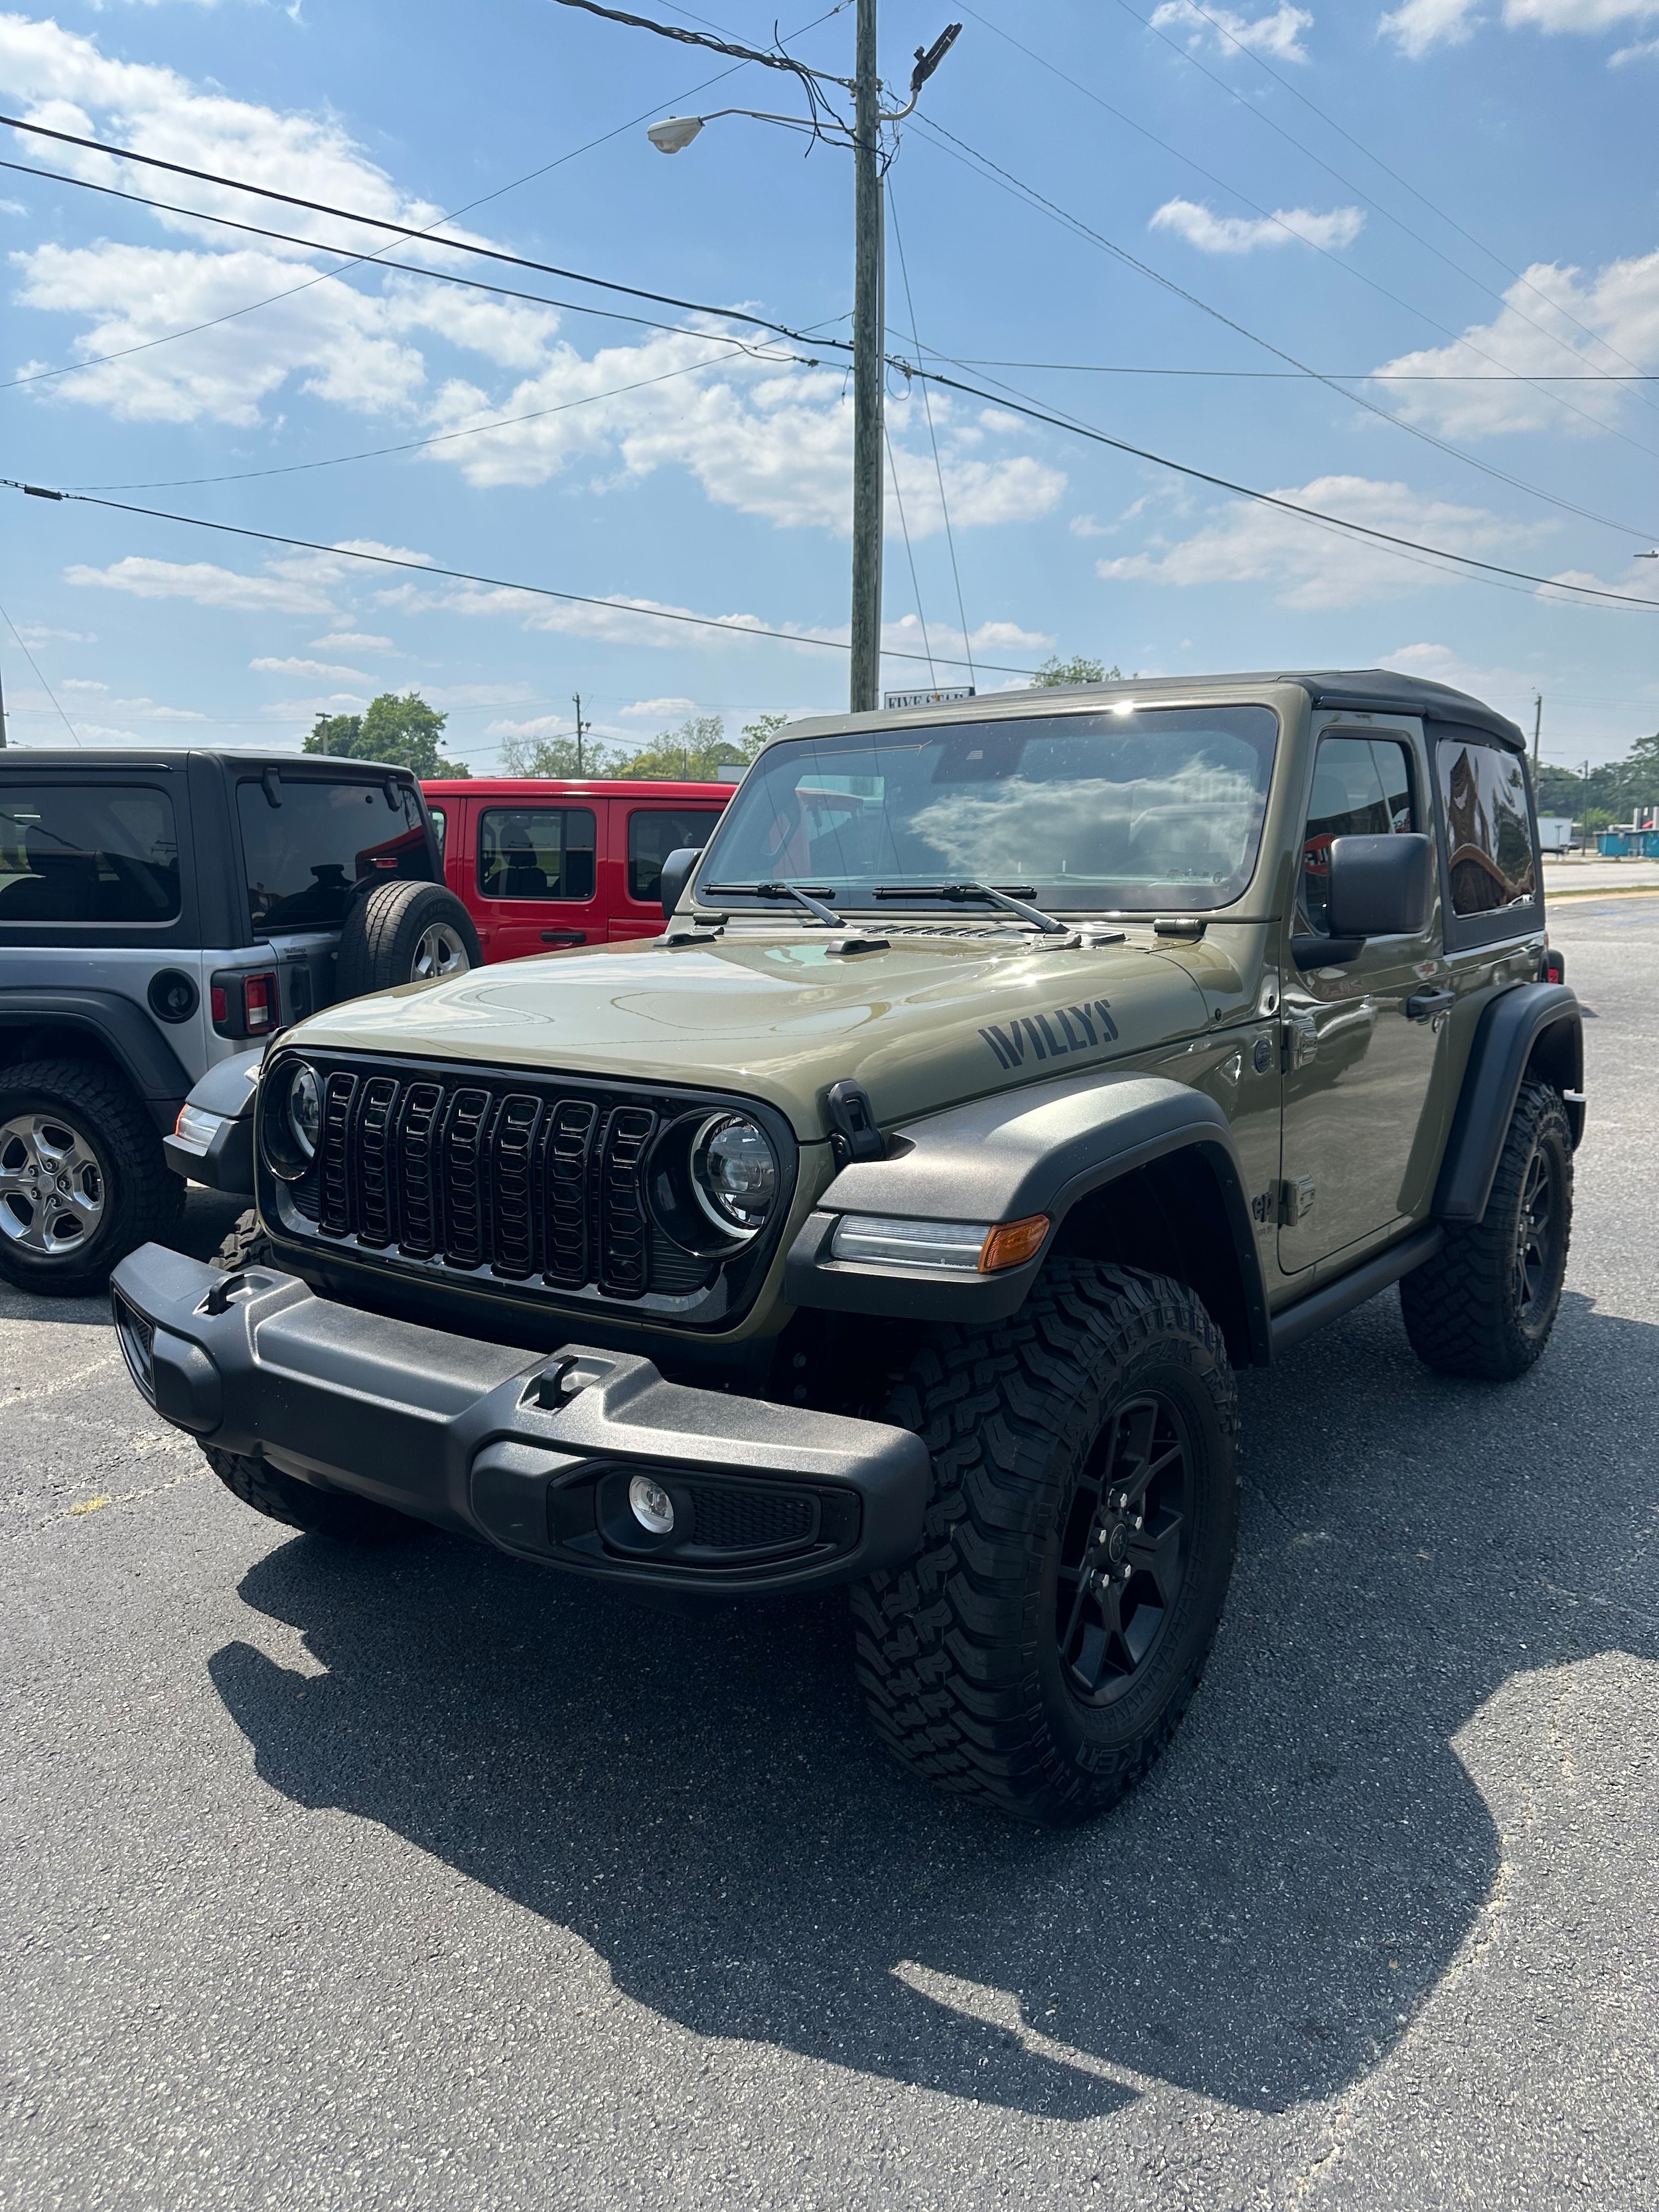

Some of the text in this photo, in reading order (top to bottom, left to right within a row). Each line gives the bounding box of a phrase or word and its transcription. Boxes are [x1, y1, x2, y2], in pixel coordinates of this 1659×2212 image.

[888, 695, 922, 709] FIVE
[977, 999, 1119, 1070] WILLYS
[1252, 1191, 1273, 1222] ep
